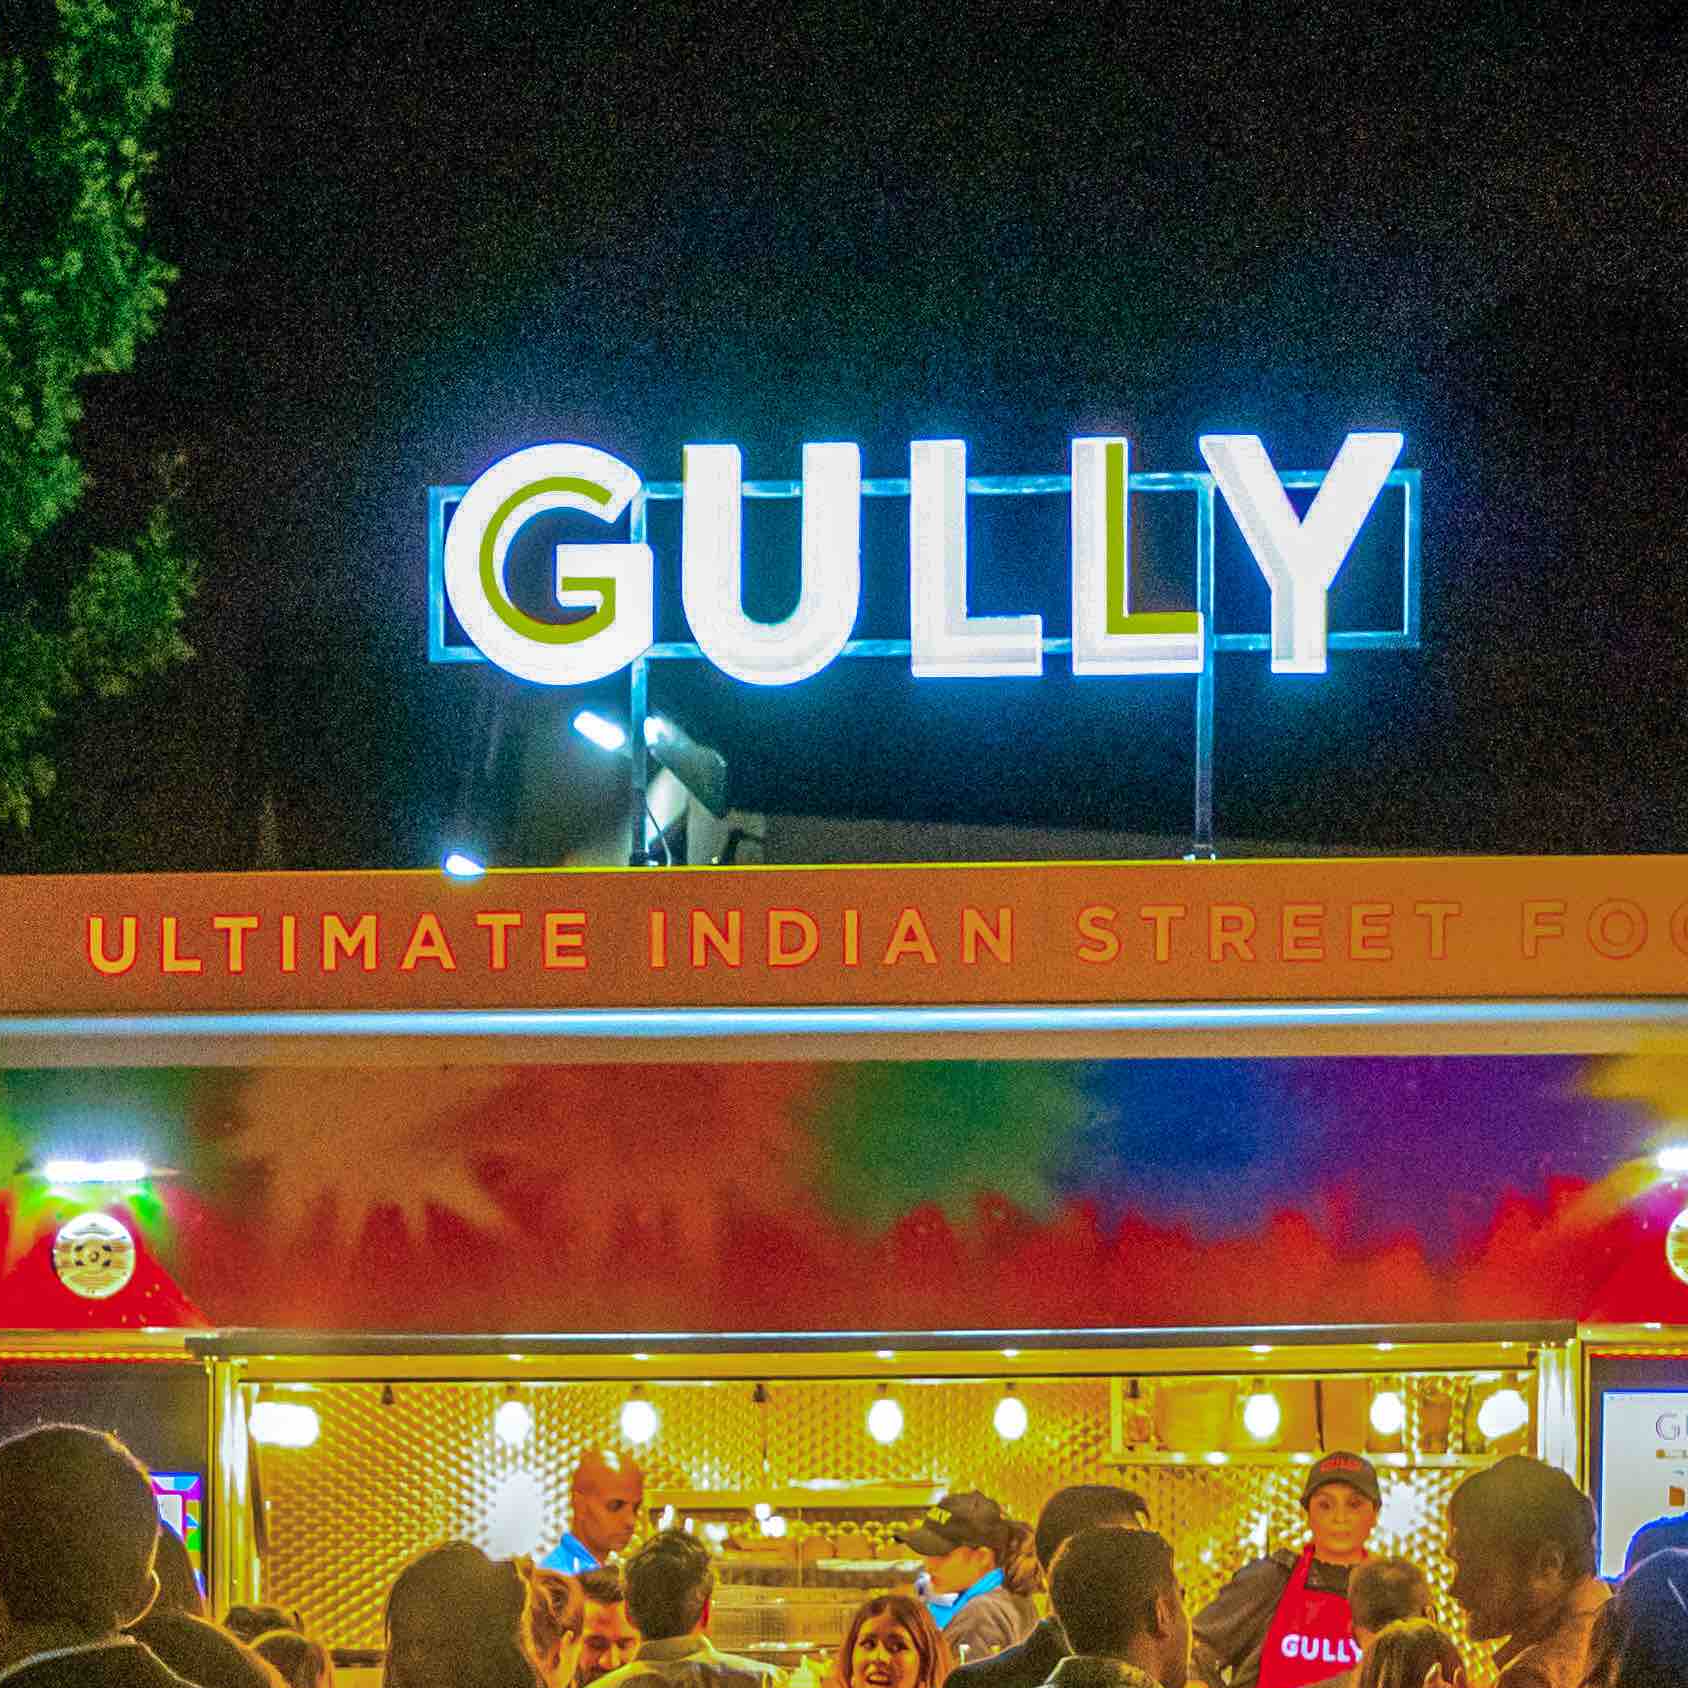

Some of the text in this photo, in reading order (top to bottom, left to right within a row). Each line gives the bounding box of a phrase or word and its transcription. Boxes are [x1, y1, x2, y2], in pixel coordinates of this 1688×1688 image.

[444, 432, 1405, 686] GULLY
[87, 910, 588, 976] ULTIMATE
[648, 906, 1014, 969] INDIAN
[1076, 902, 1463, 963] STREET
